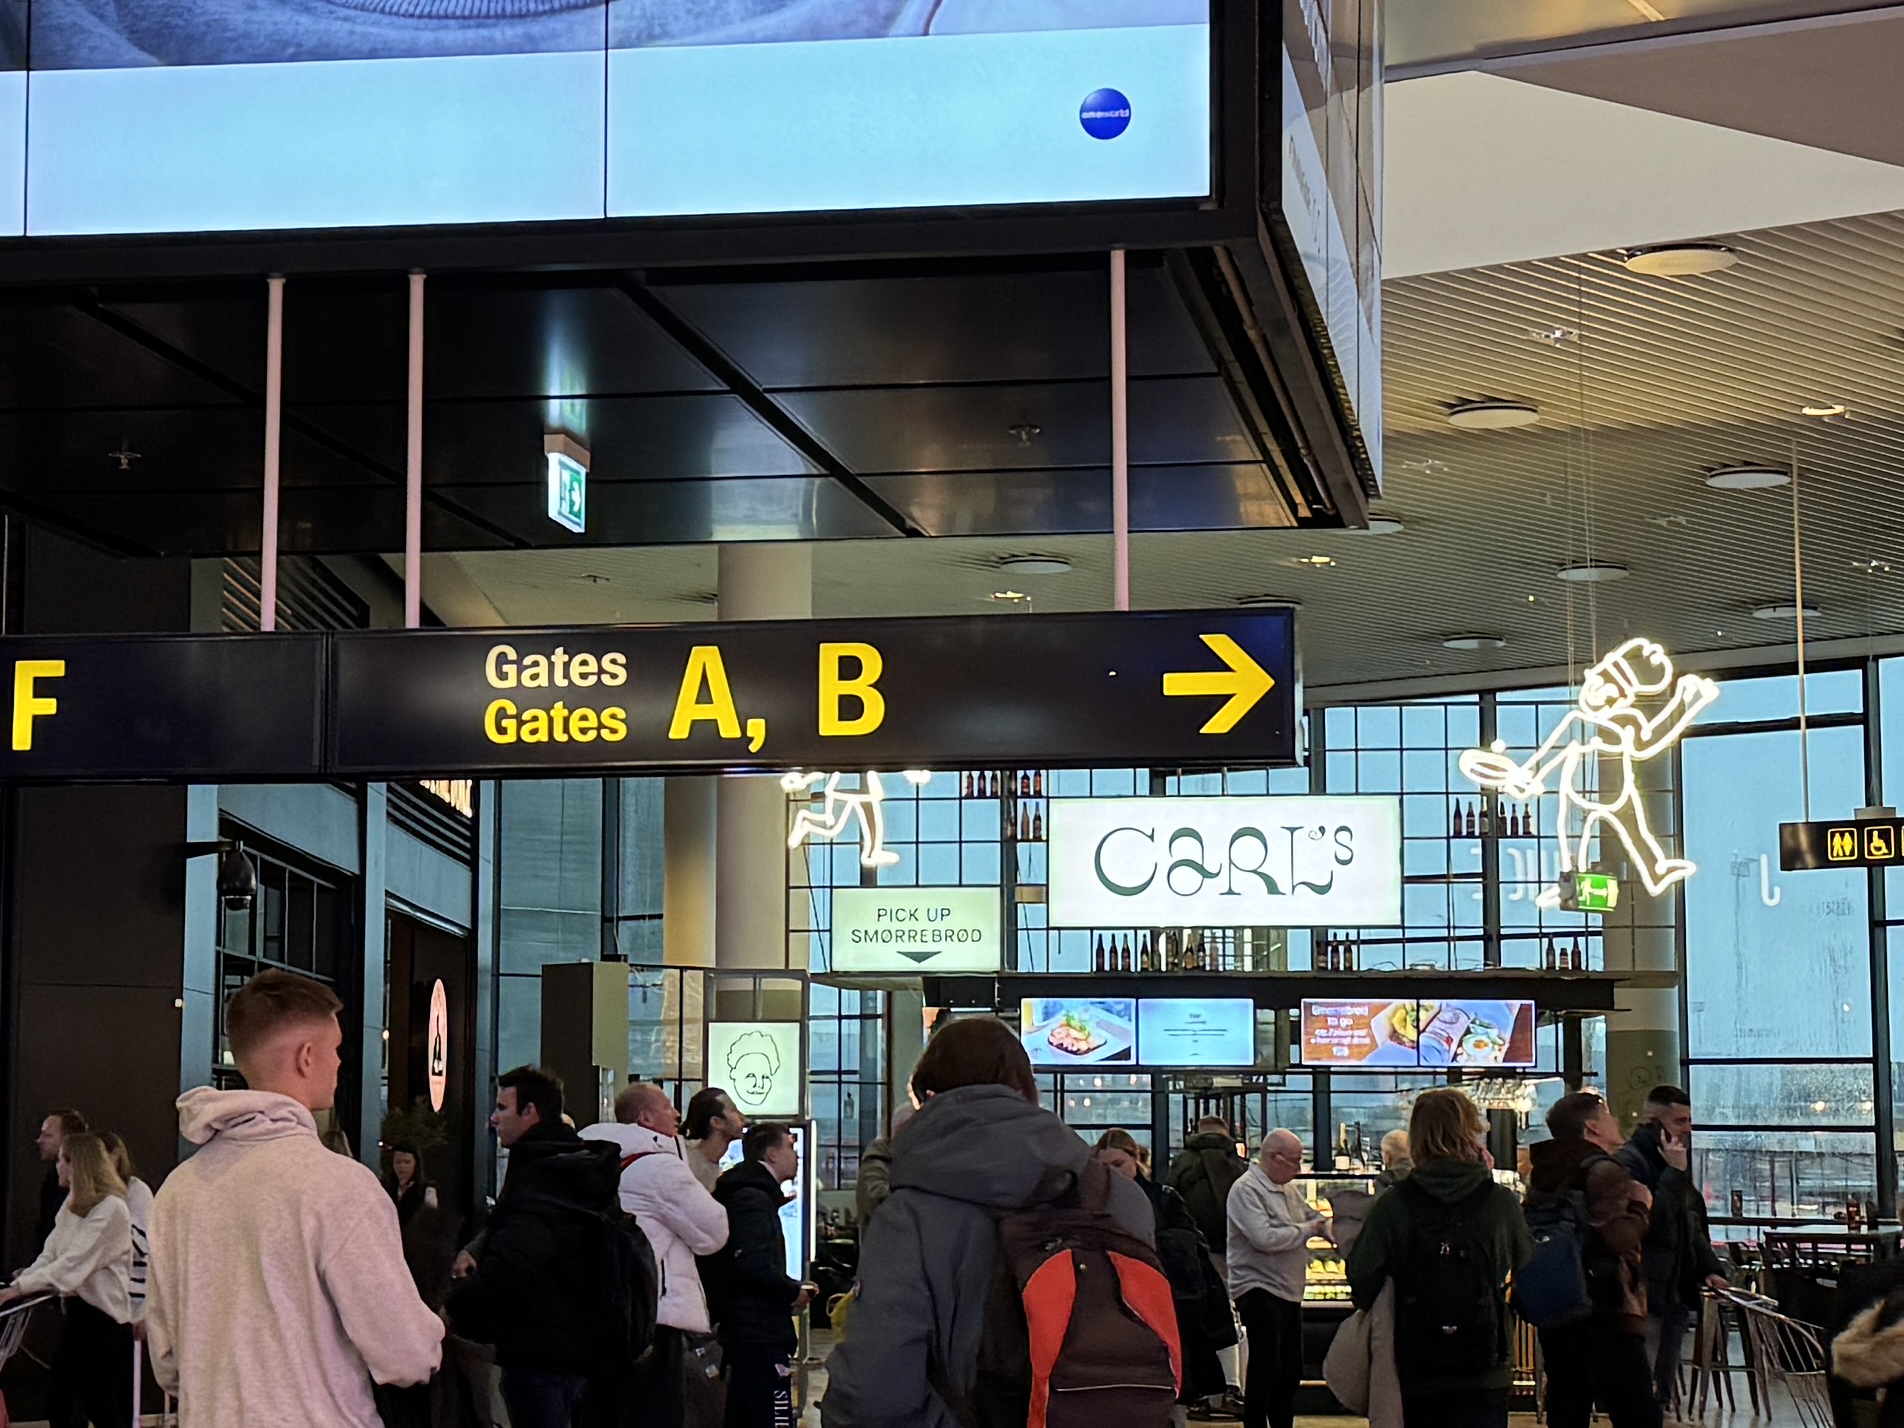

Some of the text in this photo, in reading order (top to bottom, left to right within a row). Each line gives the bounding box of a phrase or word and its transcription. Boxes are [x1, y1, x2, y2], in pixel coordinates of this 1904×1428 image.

[485, 645, 628, 689] Gates
[668, 642, 886, 754] A, B
[484, 699, 628, 744] Gates
[851, 928, 983, 944] SMØRREBRØD
[876, 907, 951, 923] PICK UP
